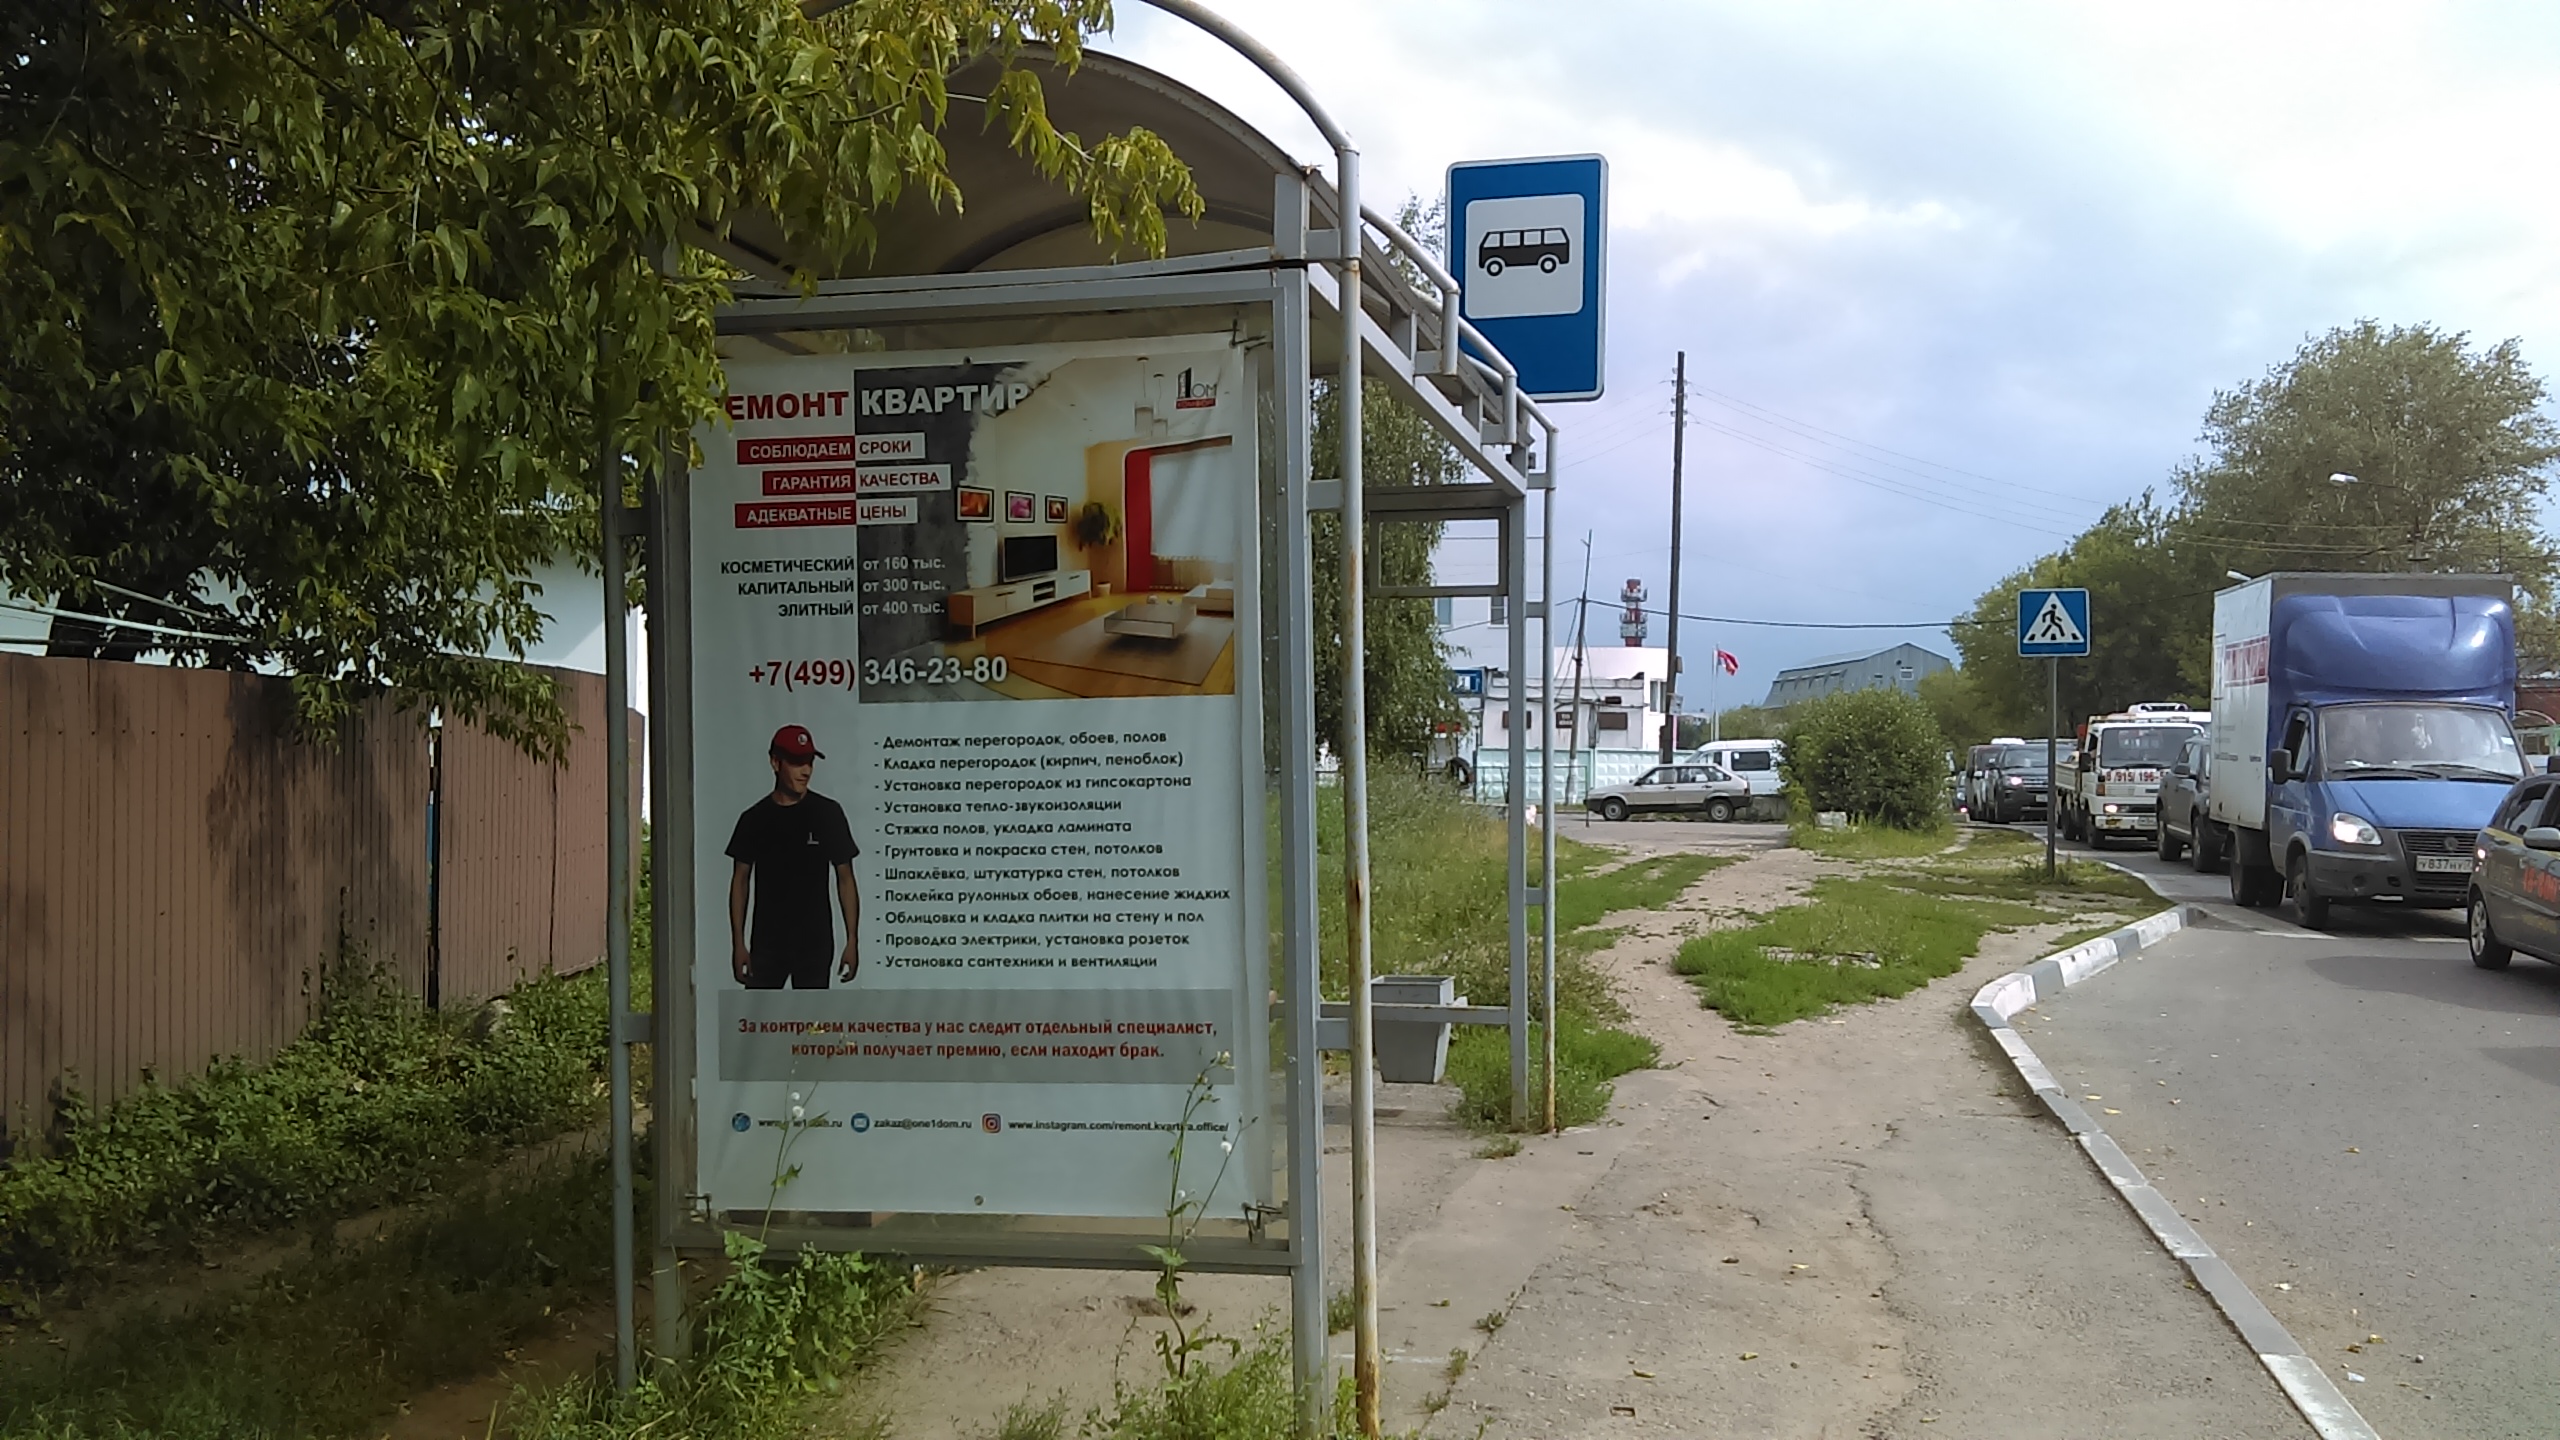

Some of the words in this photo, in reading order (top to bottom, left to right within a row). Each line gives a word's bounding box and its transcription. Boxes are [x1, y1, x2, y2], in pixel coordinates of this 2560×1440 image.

[716, 391, 849, 420] ЕМОНТ
[861, 383, 1029, 416] КВАРТИР
[750, 442, 850, 459] СОБЛЮДАЕМ
[859, 440, 912, 456] СРОКИ
[772, 475, 851, 490] ГАРАНТИЯ
[860, 471, 940, 488] КАЧЕСТВА
[747, 507, 852, 524] АДЕКВАТНЫЕ
[861, 504, 907, 521] ЦЕНЫ
[721, 554, 855, 575] КОСМЕТИЧЕСКИЙ
[863, 559, 879, 571] от
[884, 556, 908, 571] 160
[913, 558, 945, 570] тыс.
[738, 577, 854, 597] КАПИТАЛЬНЫЙ
[863, 581, 879, 593] от
[883, 577, 908, 592] 300
[912, 579, 945, 592] тыс.
[778, 600, 854, 617] ЭЛИТНЫЙ
[863, 604, 879, 616] от
[882, 600, 908, 615] 400
[912, 602, 944, 614] тыс.
[749, 659, 856, 692] +7(499)
[864, 656, 1008, 685] 346-23-80
[883, 735, 960, 750] Демонтаж
[965, 735, 1065, 750] перегородок,
[1069, 731, 1118, 745] обоев,
[1124, 732, 1166, 744] полов
[884, 757, 935, 771] Кладка
[940, 757, 1036, 772] перегородок
[1041, 754, 1101, 771] (кирпич,
[1106, 751, 1183, 768] пеноблок)
[884, 779, 961, 792] Установка
[966, 778, 1062, 793] перегородок
[1066, 778, 1081, 789] из
[1086, 776, 1191, 790] гипсокартона
[884, 800, 961, 814] Установка
[966, 800, 1121, 815] тепло-звукоизоляции
[885, 822, 938, 836] Стяжка
[943, 824, 988, 836] полов,
[994, 823, 1053, 837] укладка
[1058, 822, 1131, 834] ламината
[885, 844, 958, 860] Грунтовка
[963, 846, 971, 857] и
[976, 845, 1046, 859] покраска
[1051, 845, 1089, 857] стен,
[1095, 844, 1163, 855] потолков
[885, 866, 969, 881] Шпаклёвка,
[974, 868, 1063, 883] штукатурка
[1067, 868, 1106, 879] стен,
[1111, 867, 1179, 878] потолков
[885, 888, 953, 903] Поклейка
[958, 891, 1029, 905] рулонных
[1034, 887, 1082, 902] обоев,
[1087, 889, 1169, 901] нанесение
[1175, 889, 1230, 901] жидких
[885, 910, 966, 925] Облицовка
[971, 913, 978, 924] и
[983, 913, 1034, 925] кладка
[1039, 913, 1088, 923] плитки
[1094, 912, 1111, 923] на
[1116, 912, 1159, 926] стену
[1165, 912, 1172, 923] и
[1178, 912, 1204, 923] пол
[886, 933, 956, 949] Проводка
[961, 935, 1040, 949] электрики,
[1045, 934, 1124, 949] установка
[1129, 934, 1189, 948] розеток
[885, 955, 963, 968] Установка
[968, 957, 1053, 968] сантехники
[1059, 958, 1066, 968] и
[1072, 957, 1157, 969] вентиляции
[738, 1018, 756, 1034] За
[848, 1021, 921, 1033] качества
[925, 1022, 933, 1036] у
[936, 1021, 964, 1034] нас
[969, 1021, 1021, 1036] следит
[1025, 1018, 1112, 1036] отдельный
[1117, 1021, 1217, 1037] специалист,
[792, 1043, 858, 1060] который
[863, 1044, 933, 1060] получает
[937, 1044, 1005, 1060] премию,
[1011, 1045, 1047, 1057] если
[1052, 1045, 1115, 1060] находит
[1120, 1042, 1164, 1061] брак.
[1008, 1119, 1229, 1132] www.instagram.com/remont.kvarta.office/
